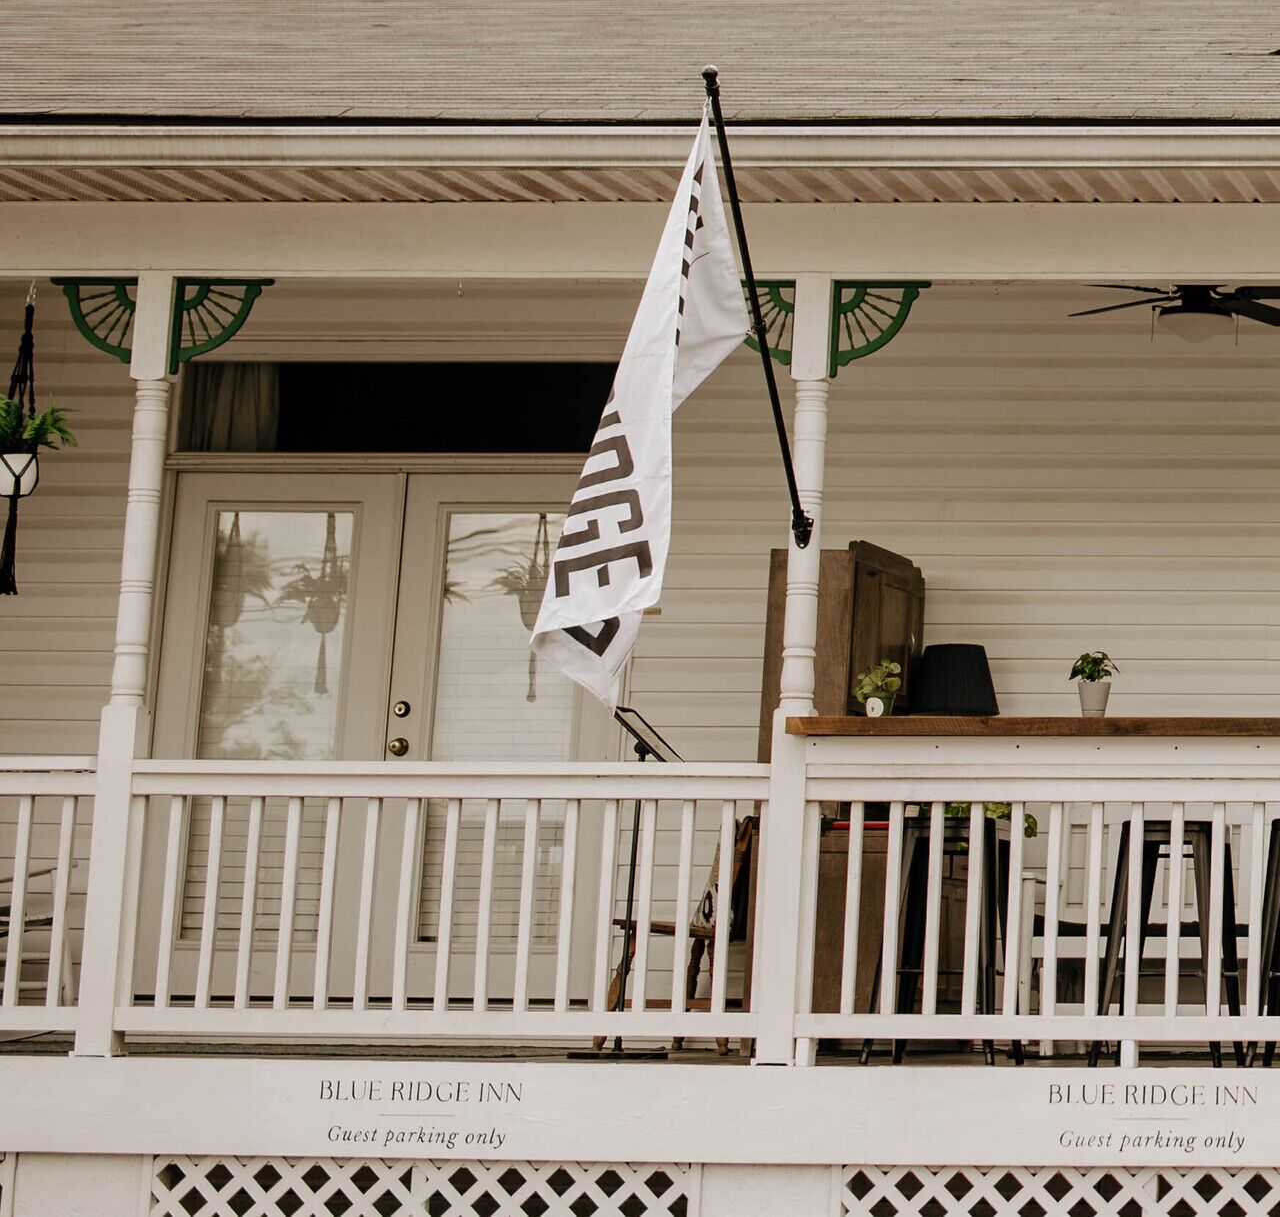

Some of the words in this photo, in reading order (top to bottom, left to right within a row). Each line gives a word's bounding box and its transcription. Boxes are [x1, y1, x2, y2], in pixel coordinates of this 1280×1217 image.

[319, 1080, 382, 1101] BLUE
[391, 1081, 470, 1103] RIDGE
[479, 1082, 523, 1103] INN
[1048, 1084, 1115, 1105] BLUE
[1125, 1084, 1206, 1106] RIDGE
[1215, 1085, 1259, 1105] INN
[327, 1125, 378, 1143] Guest
[384, 1126, 460, 1150] parking
[465, 1128, 506, 1150] only
[1059, 1130, 1112, 1148] Guest
[1119, 1130, 1197, 1152] parking
[1204, 1130, 1246, 1153] only
